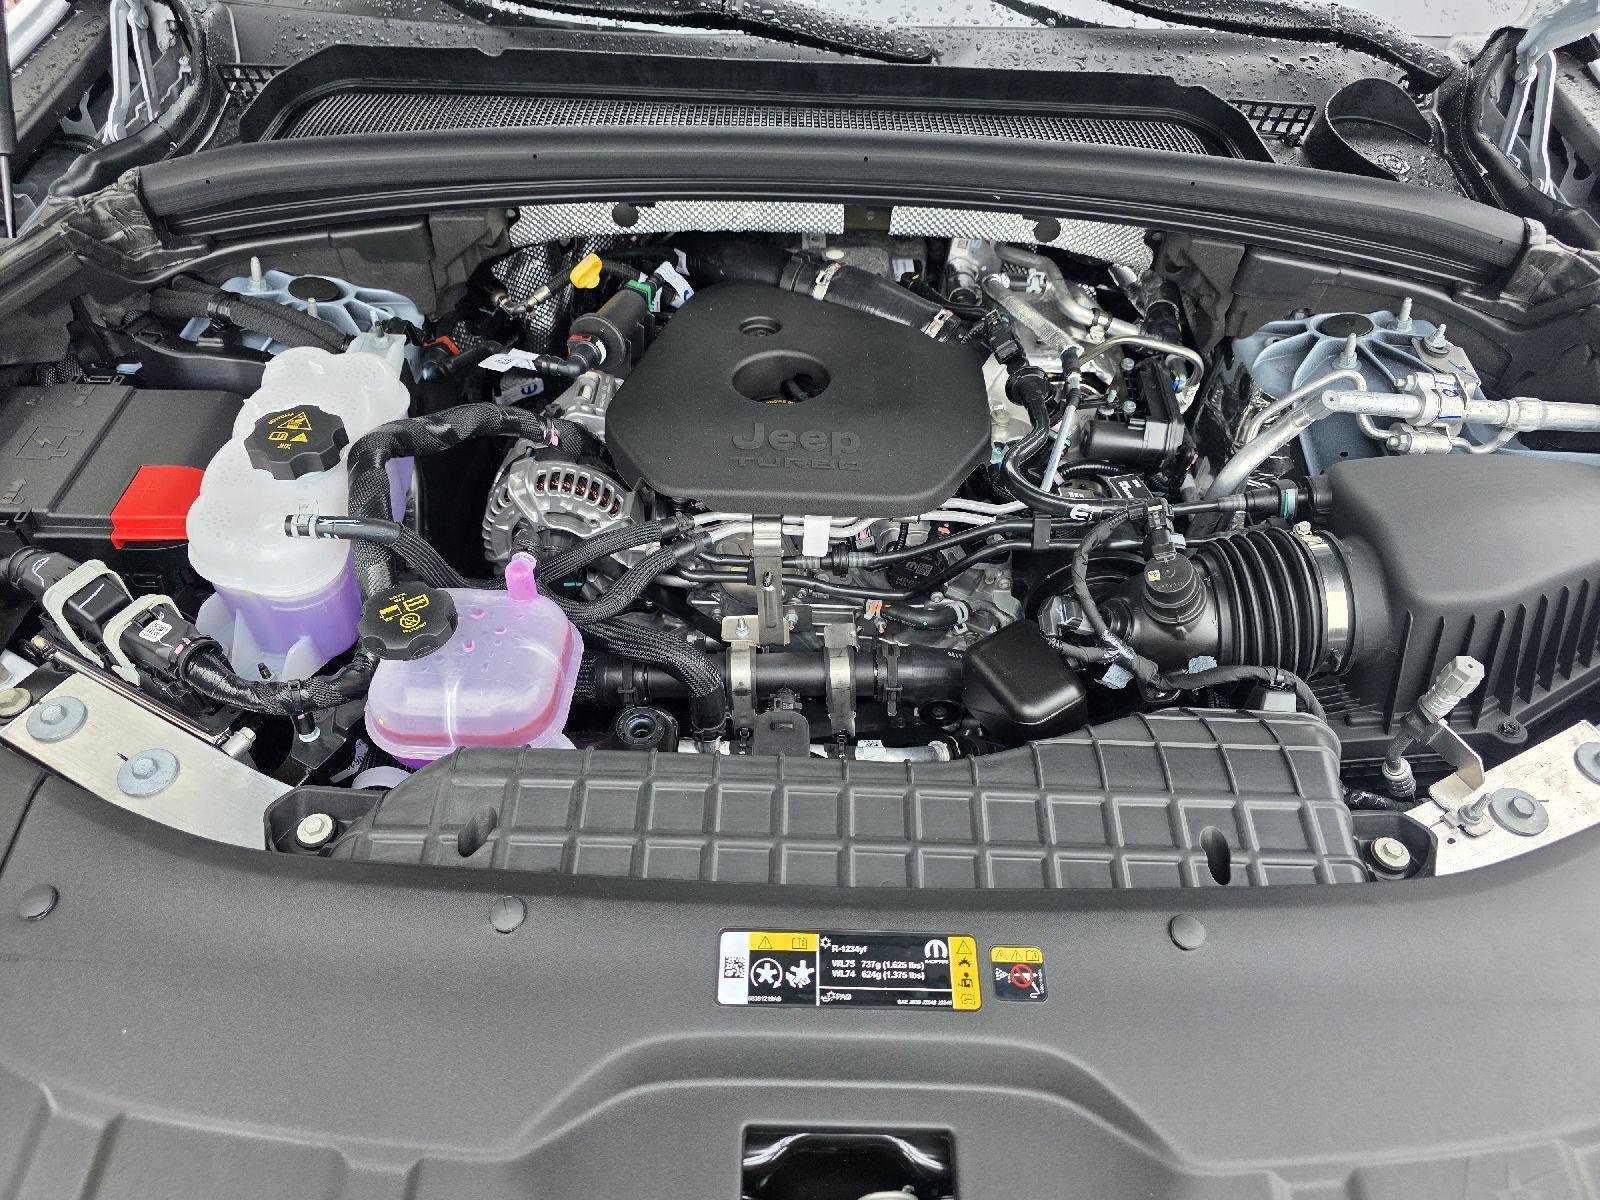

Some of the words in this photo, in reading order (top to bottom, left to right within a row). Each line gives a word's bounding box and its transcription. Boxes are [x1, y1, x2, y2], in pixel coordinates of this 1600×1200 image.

[732, 422, 861, 457] Jeep
[729, 456, 862, 472] TURBO
[831, 945, 868, 955] R-1234yf
[831, 959, 856, 968] WL75
[861, 960, 881, 970] 737g
[882, 960, 907, 970] (1.625
[908, 961, 925, 970] lbs)
[831, 970, 856, 978] WL74
[861, 970, 881, 980] 624g
[883, 970, 908, 980] (1.375
[909, 971, 925, 980] lbs)
